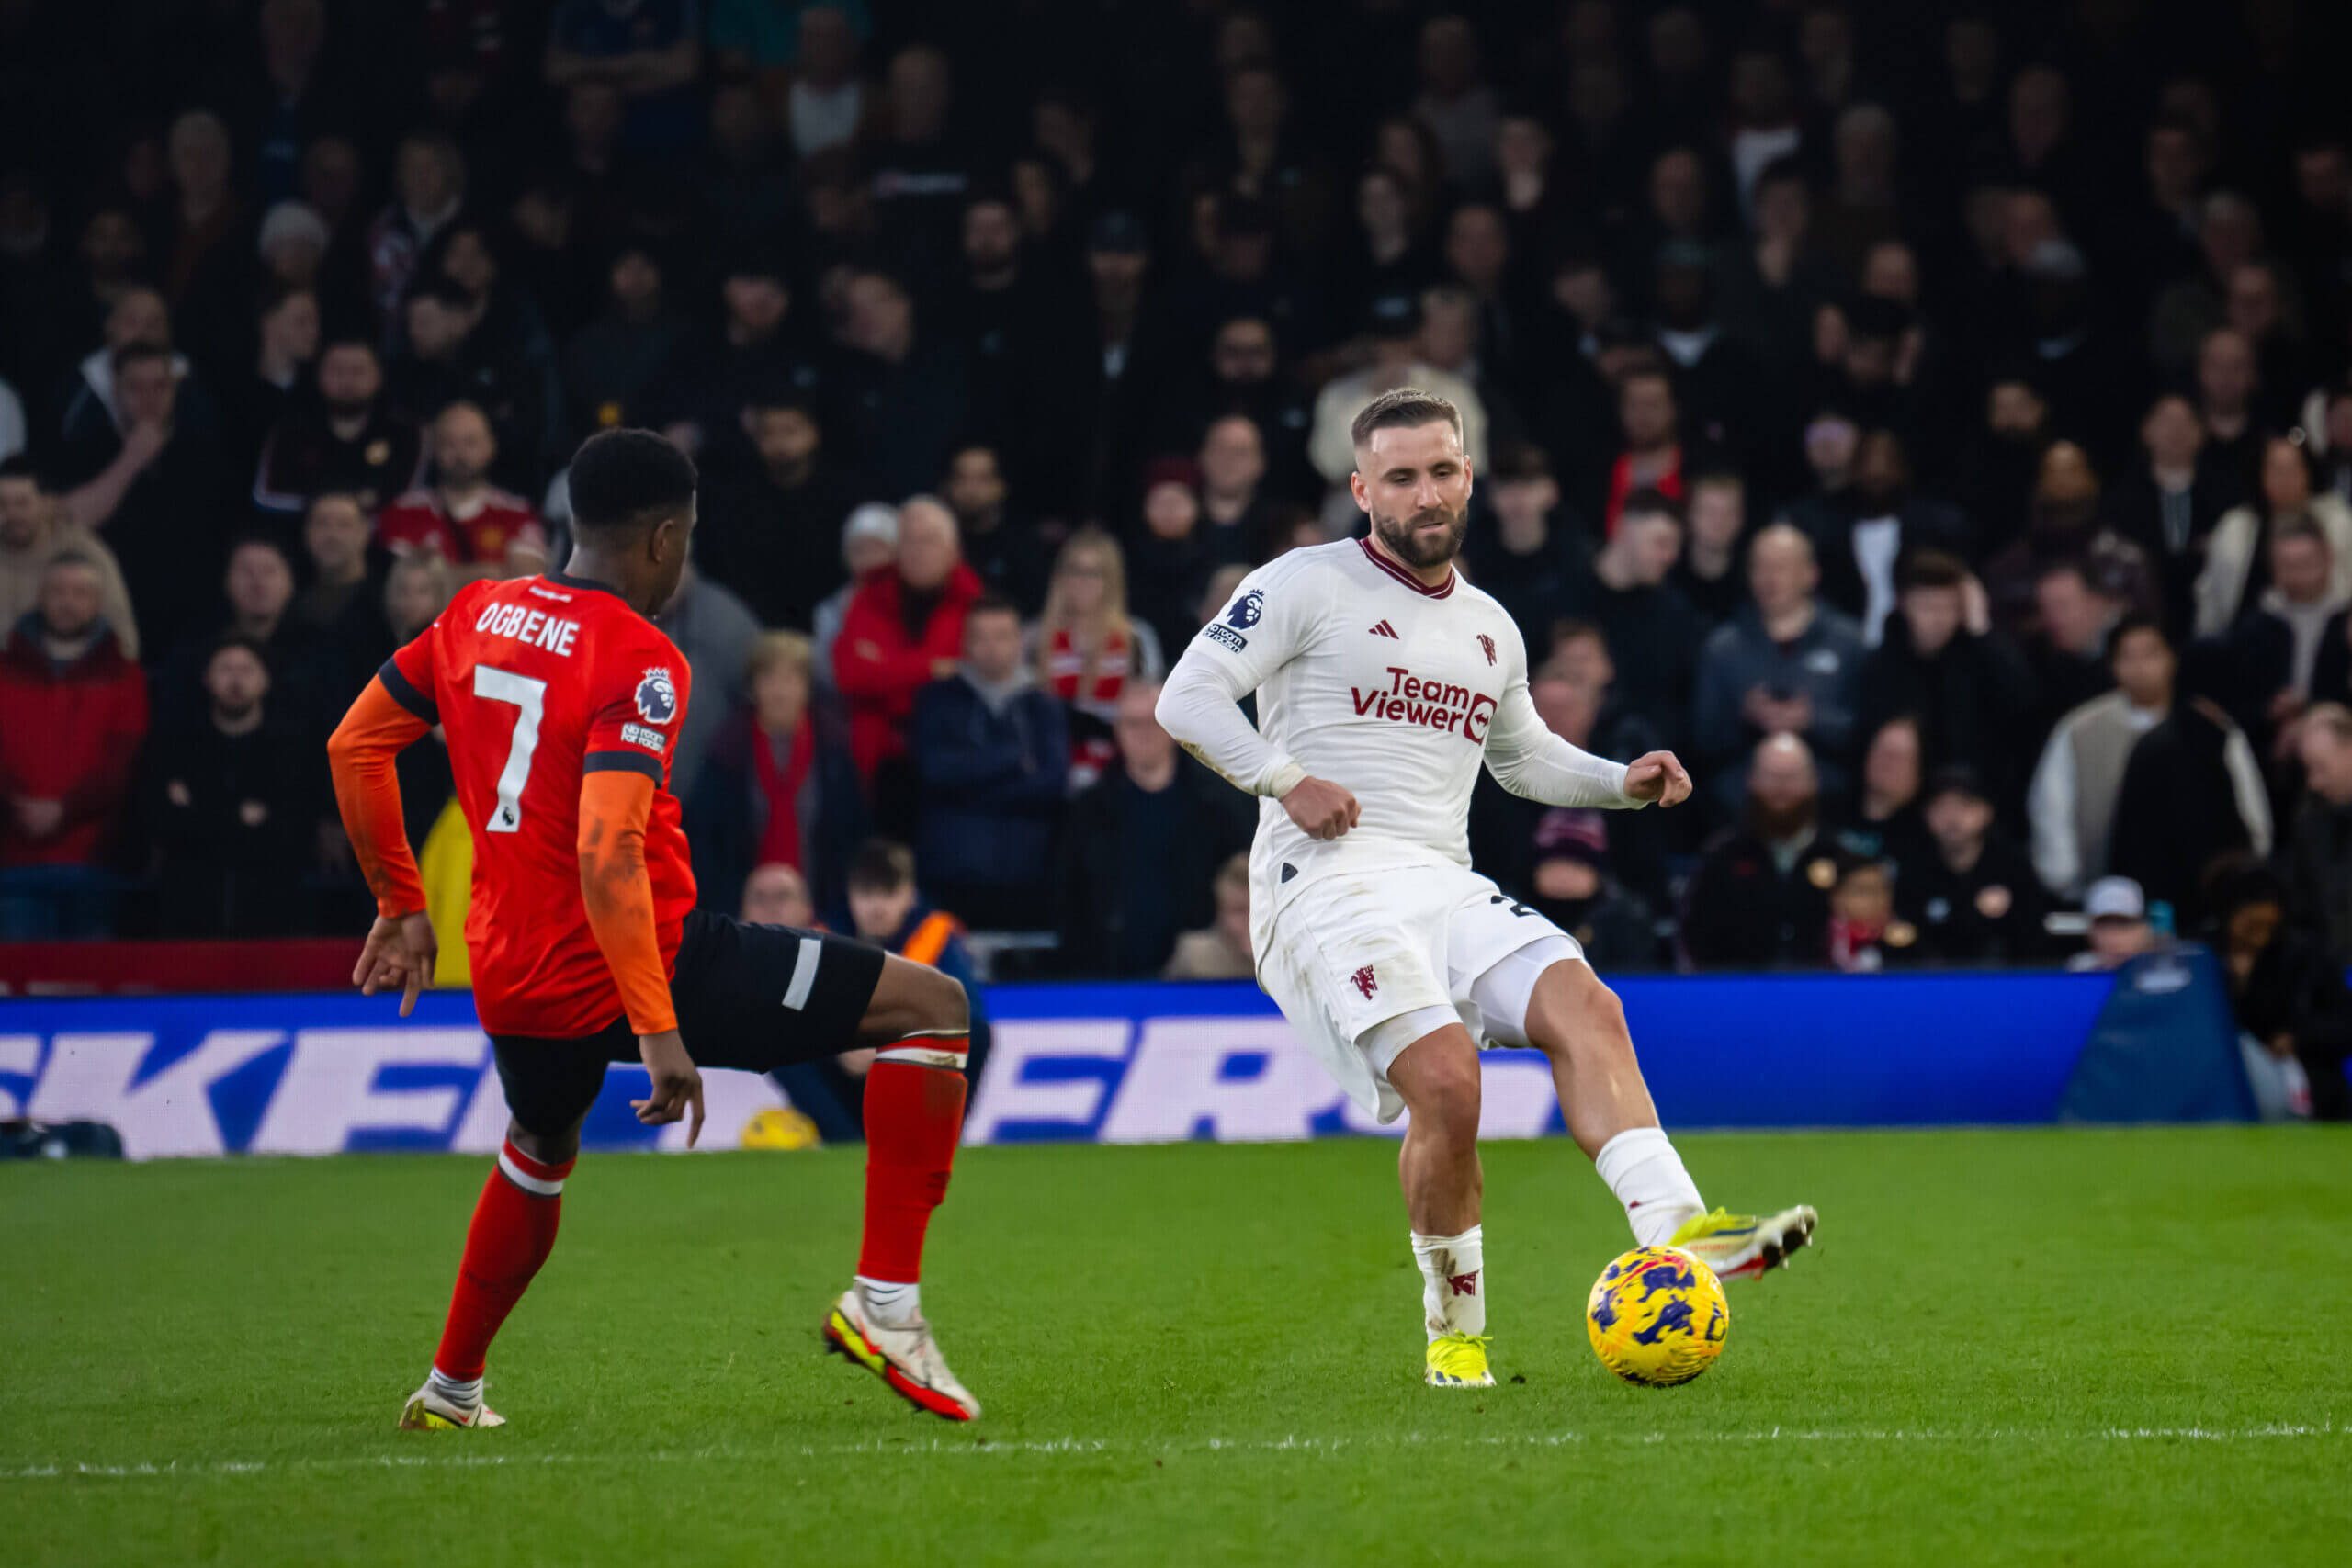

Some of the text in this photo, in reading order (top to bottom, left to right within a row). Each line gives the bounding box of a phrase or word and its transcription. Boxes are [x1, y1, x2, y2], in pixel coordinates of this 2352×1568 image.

[476, 601, 581, 658] OGBENE
[1351, 687, 1464, 733] Viewer
[1386, 667, 1470, 710] Team
[474, 663, 548, 832] 7
